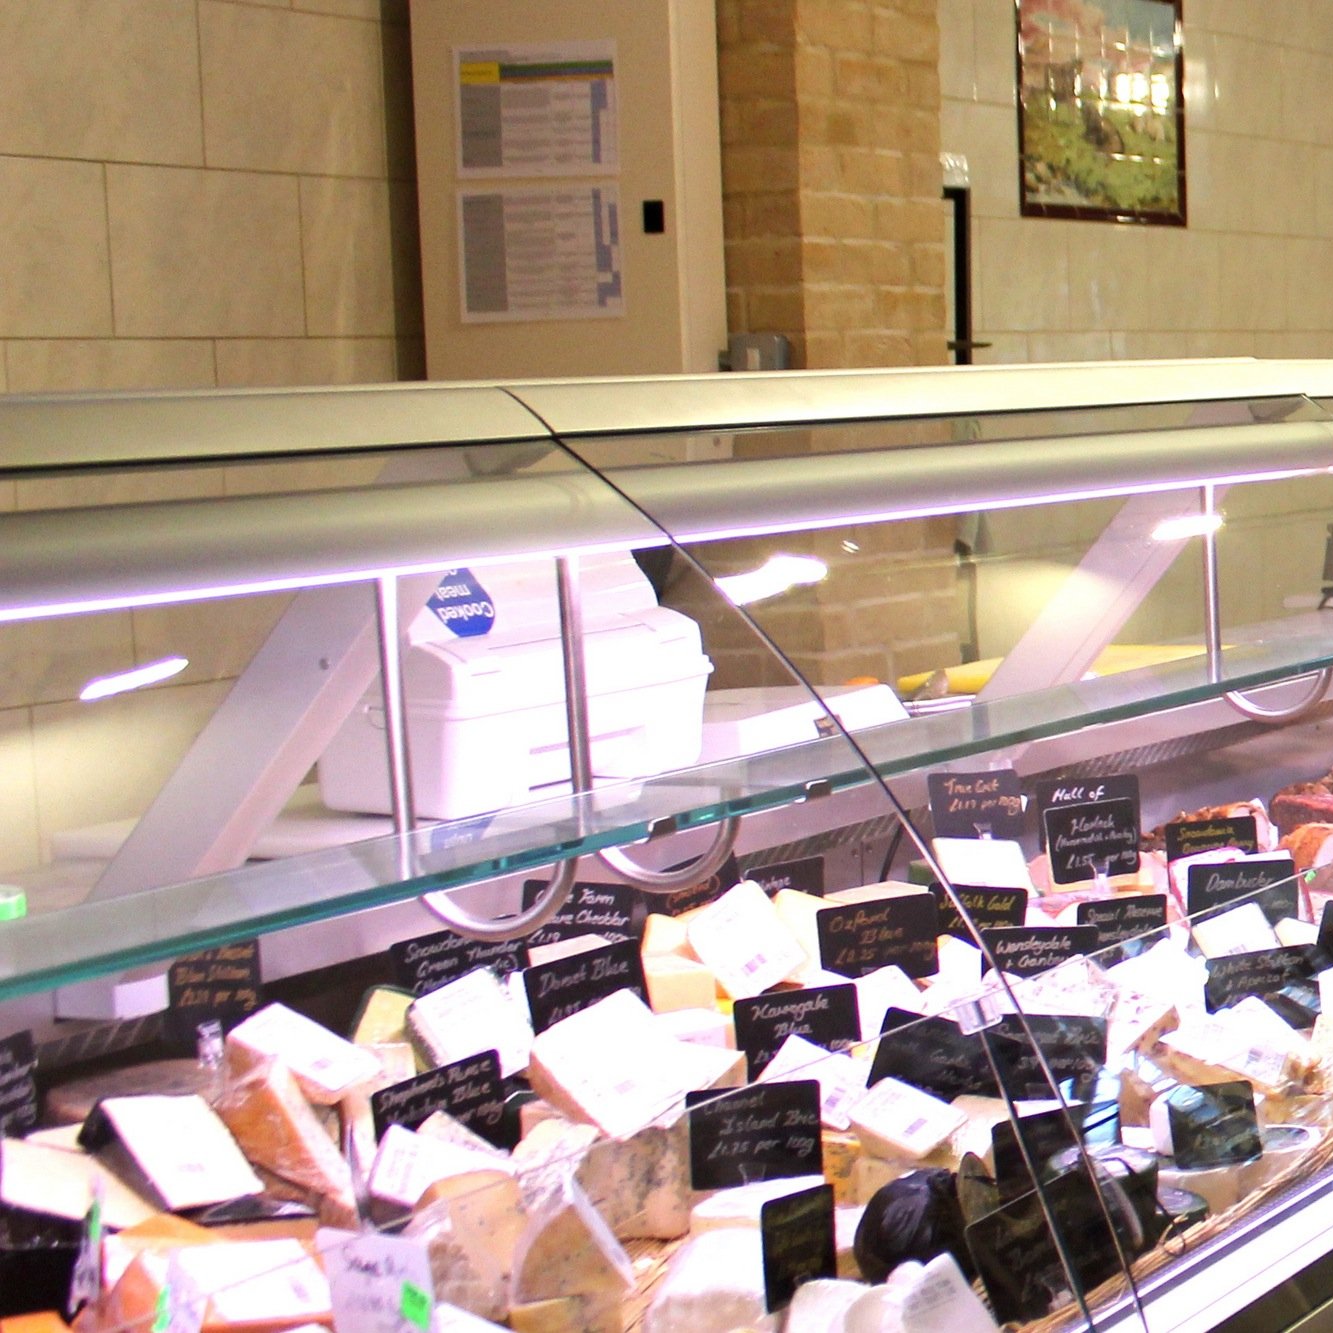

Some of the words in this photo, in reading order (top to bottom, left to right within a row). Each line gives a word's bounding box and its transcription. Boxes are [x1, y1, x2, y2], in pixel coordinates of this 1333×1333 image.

[436, 601, 496, 624] Cooked
[1088, 785, 1105, 802] of
[995, 935, 1072, 956] Wensleydale
[590, 954, 630, 981] Blue
